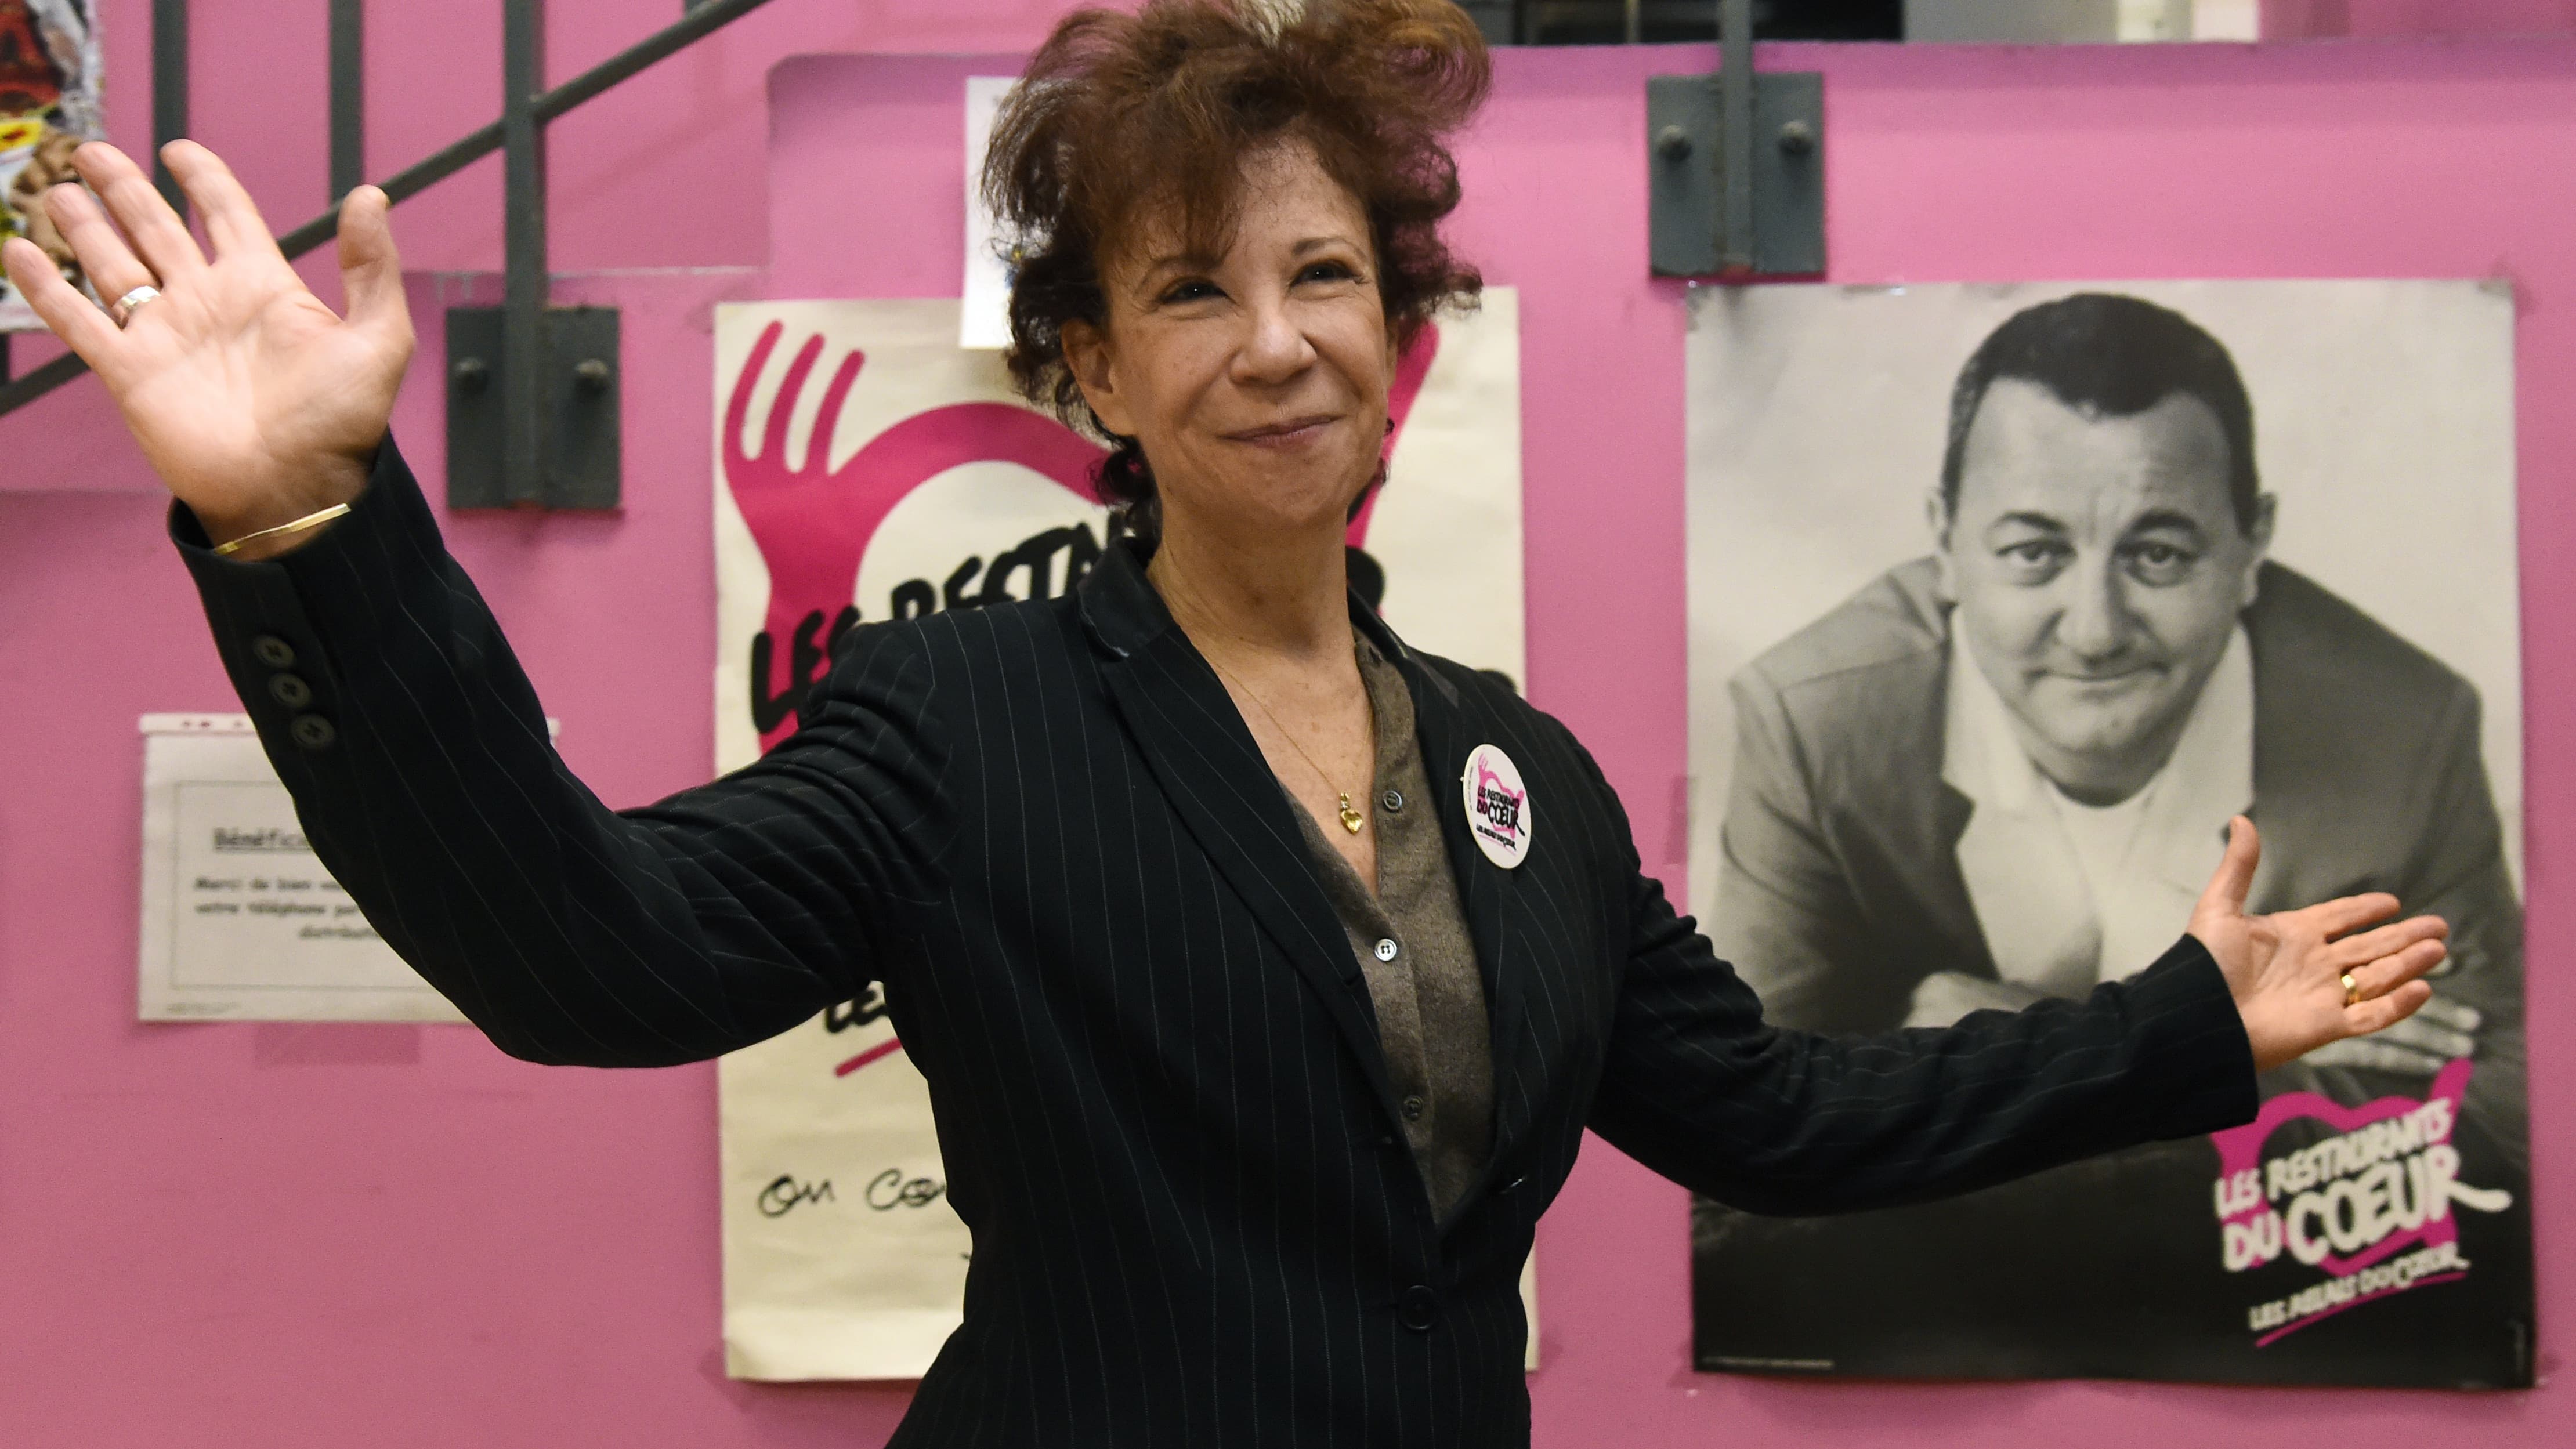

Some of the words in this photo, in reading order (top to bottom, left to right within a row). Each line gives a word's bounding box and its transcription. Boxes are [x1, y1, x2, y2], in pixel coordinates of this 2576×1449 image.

[1477, 785, 1486, 798] LES
[1477, 799, 1488, 815] DU
[2213, 1167, 2261, 1220] LES
[2265, 1096, 2453, 1202] RESTAURANTS
[2221, 1210, 2282, 1273] DU
